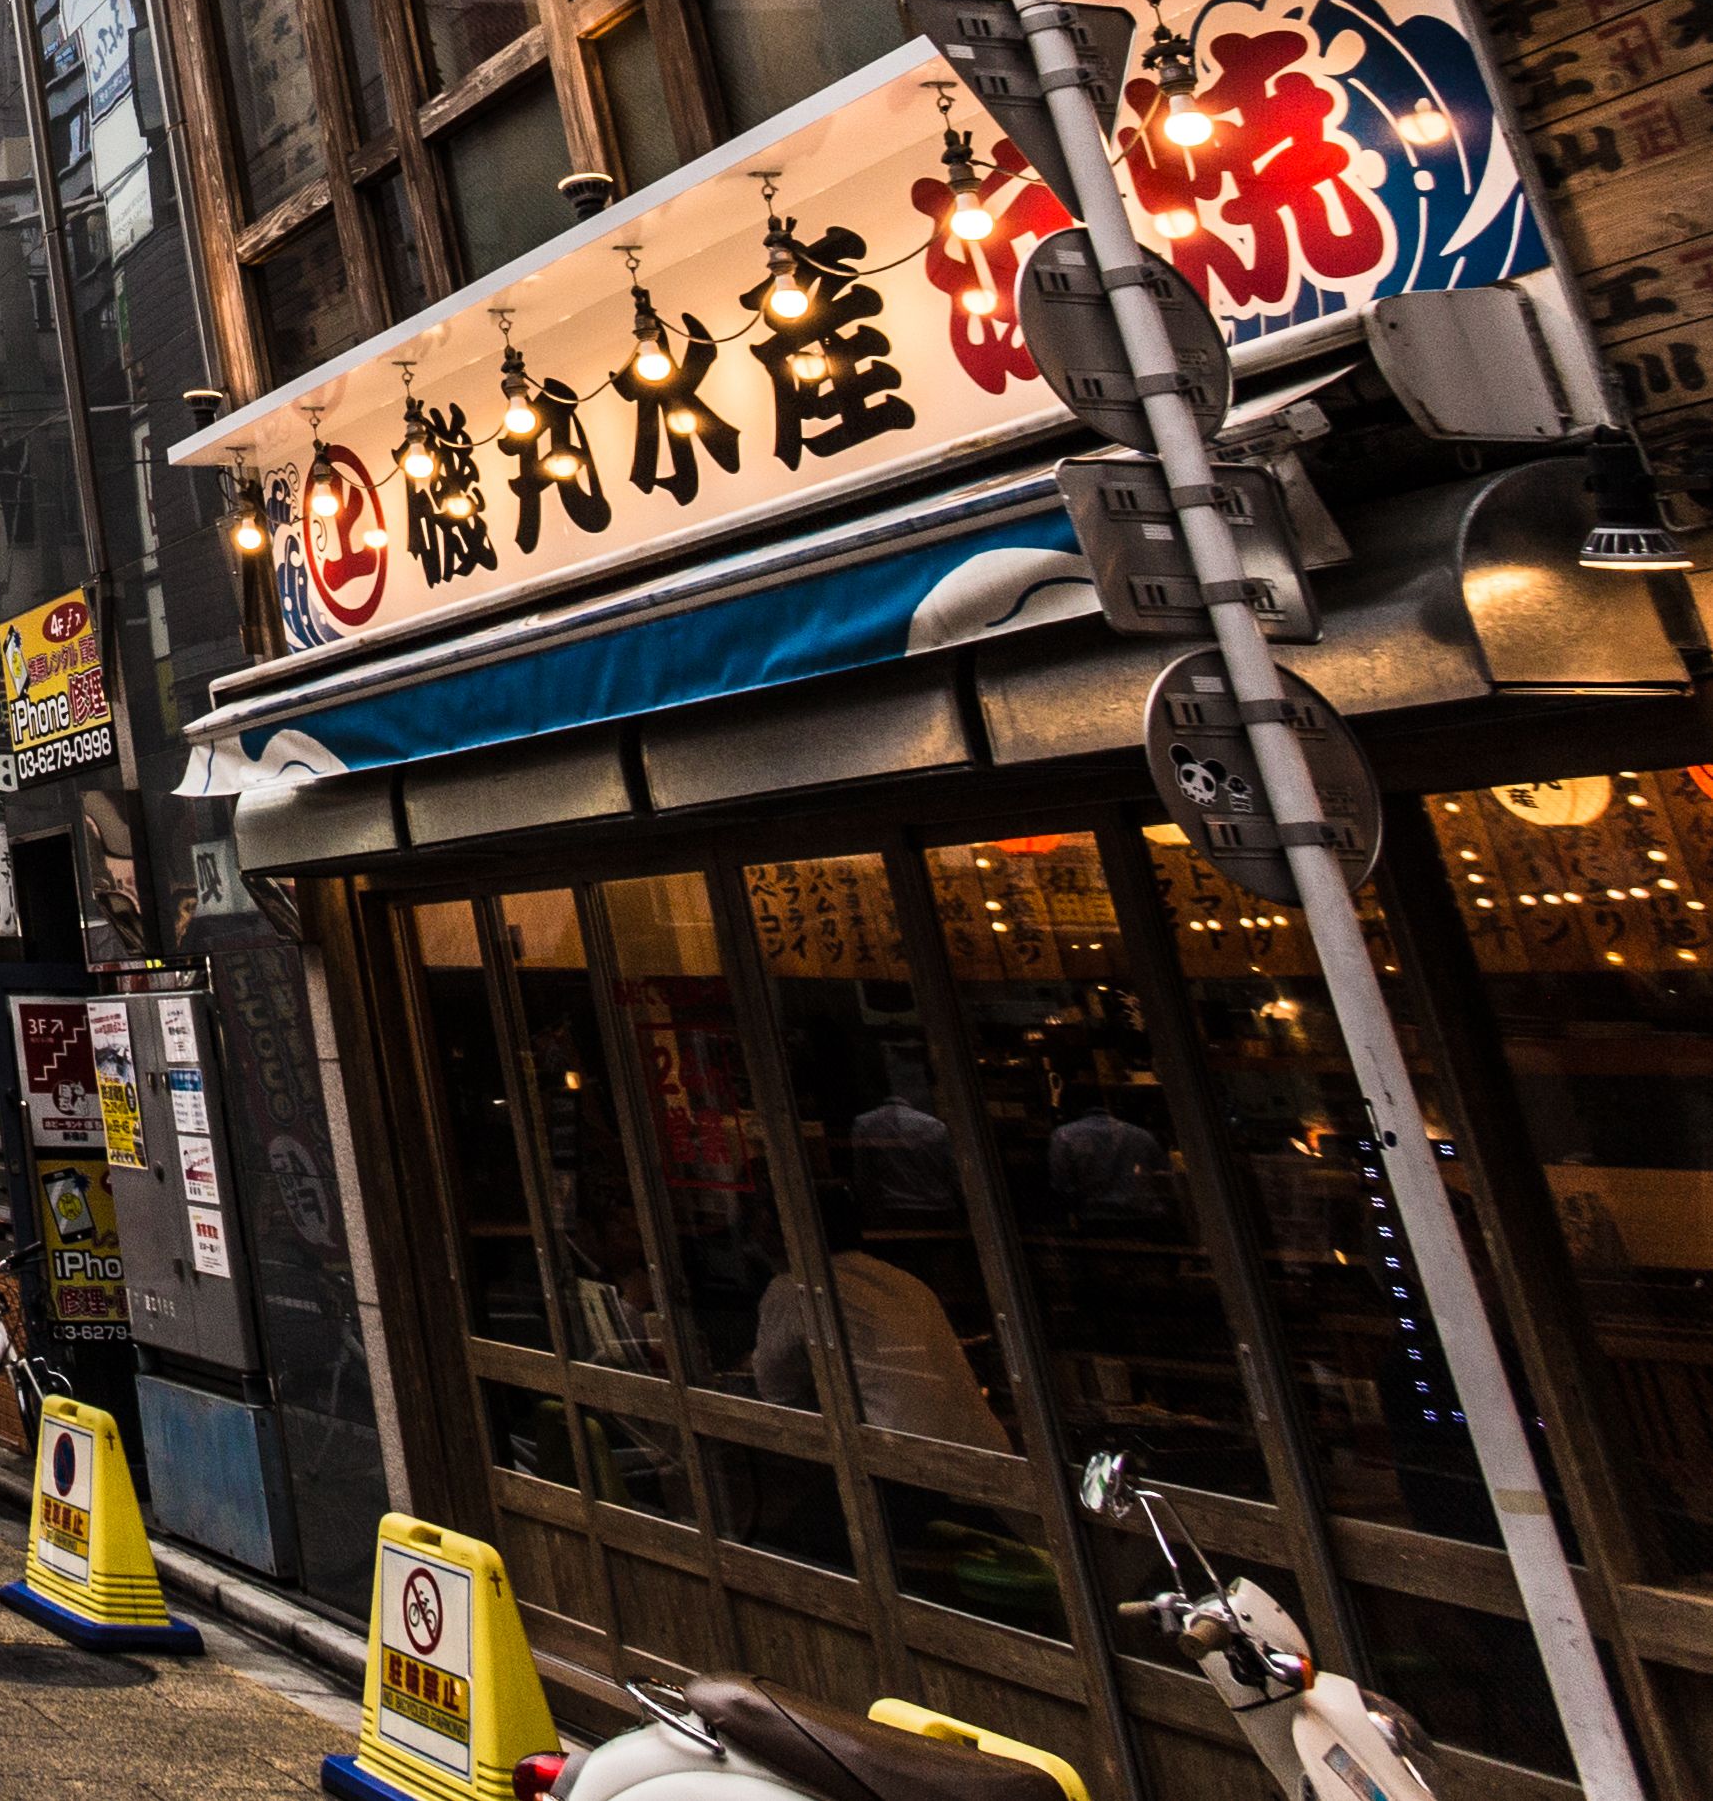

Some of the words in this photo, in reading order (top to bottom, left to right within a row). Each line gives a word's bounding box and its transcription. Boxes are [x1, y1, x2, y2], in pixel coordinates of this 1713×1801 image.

[407, 221, 918, 592] 磯丸水産
[50, 613, 65, 638] 4F
[9, 693, 71, 744] iPhone
[68, 665, 110, 728] 修理
[17, 727, 113, 781] 03-6279-0998
[27, 1018, 48, 1036] 3F
[54, 1249, 125, 1280] iPho
[387, 1652, 461, 1715] 駐輪禁止
